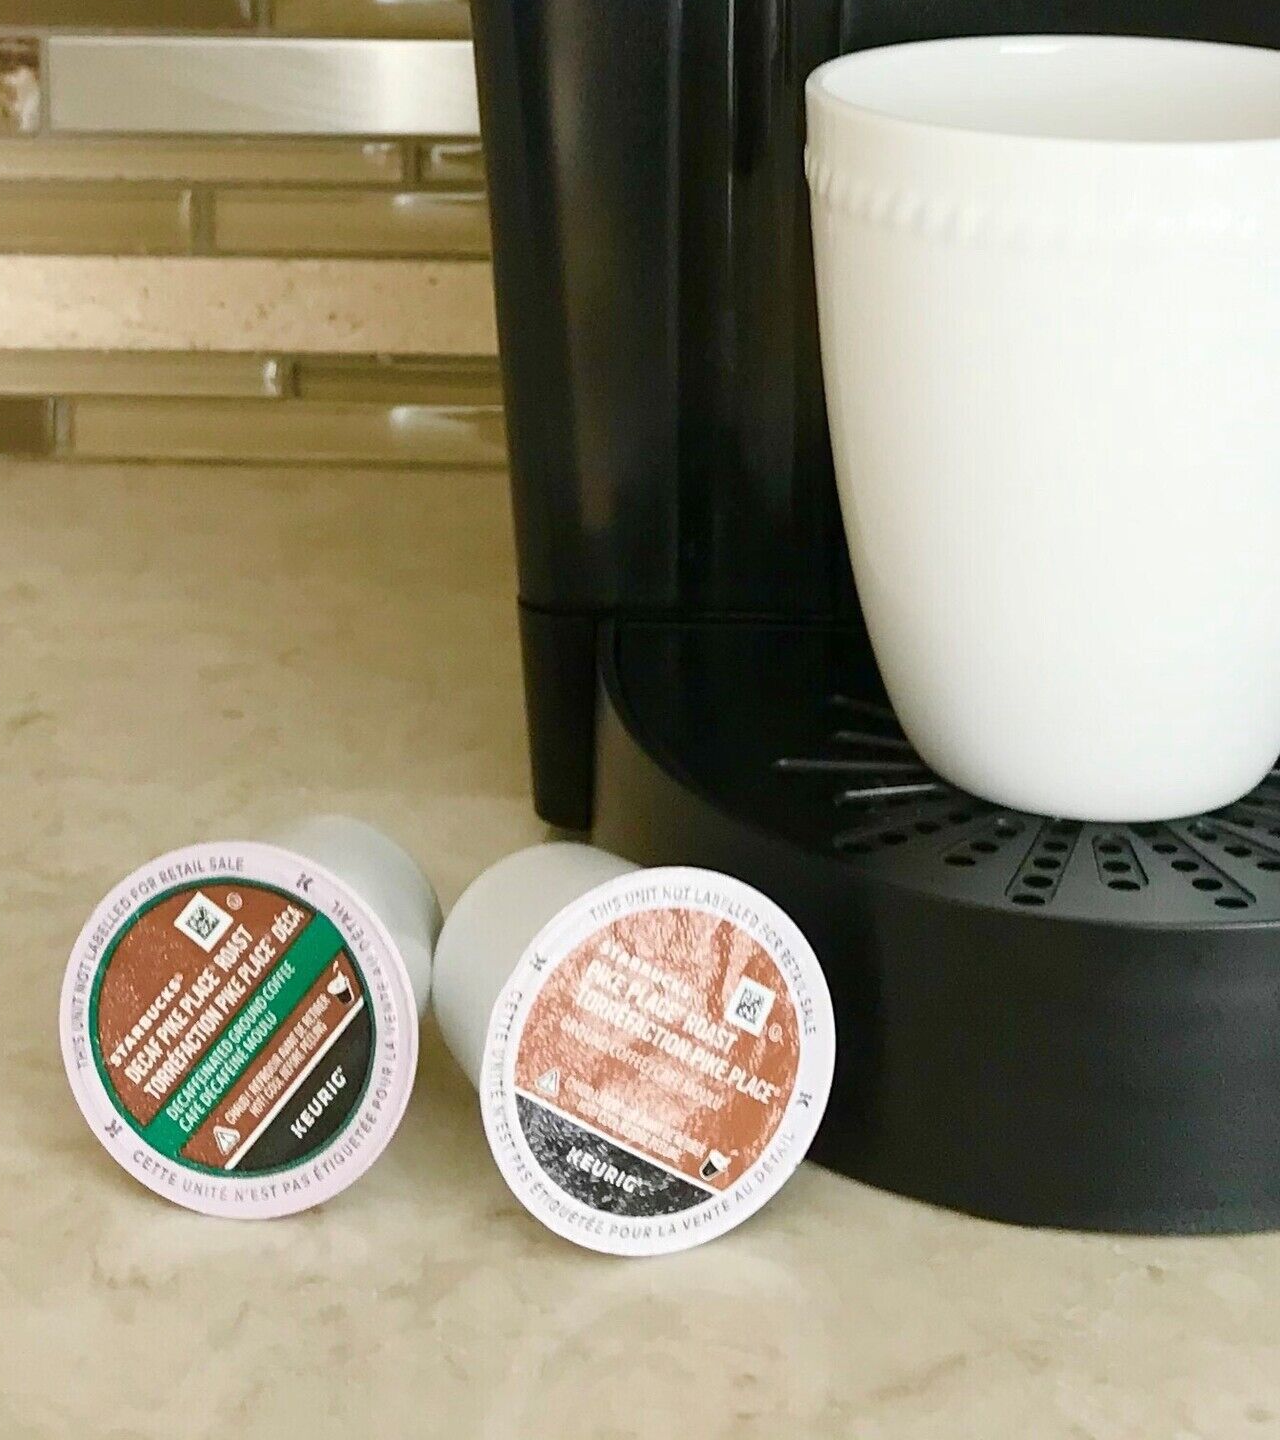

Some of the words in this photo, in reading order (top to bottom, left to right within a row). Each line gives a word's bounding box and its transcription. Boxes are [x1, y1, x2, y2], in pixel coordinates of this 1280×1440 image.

[87, 898, 131, 961] LABELLED
[131, 876, 158, 902] FOR
[158, 858, 205, 887] RETAIL
[209, 856, 245, 872] SALE
[695, 887, 759, 929] LABELLED
[124, 1036, 163, 1085] DECAF
[156, 1007, 189, 1046] PIKE
[213, 923, 253, 972] ROAST
[143, 1004, 224, 1101] TORRÉFACTION
[214, 975, 246, 1014] PIKE
[271, 904, 305, 942] DÉCA
[164, 1036, 235, 1122] DECAFFEINATED
[226, 993, 269, 1045] GROUND
[260, 959, 297, 1002] COFFEE
[241, 1009, 279, 1053] MOULU
[577, 991, 692, 1064] TORRÉFACTION
[688, 1046, 729, 1080] PIKE
[585, 960, 621, 996] PIKE
[680, 1011, 739, 1054] ROAST
[131, 1149, 177, 1186] CETTE
[234, 1187, 278, 1202] N'EST
[282, 1173, 312, 1195] PAS
[312, 1114, 377, 1182] ÉTIQUETÉE
[608, 1222, 653, 1240] POUR
[657, 1221, 678, 1236] LA
[682, 1200, 733, 1233] VENTE
[735, 1183, 755, 1204] AU
